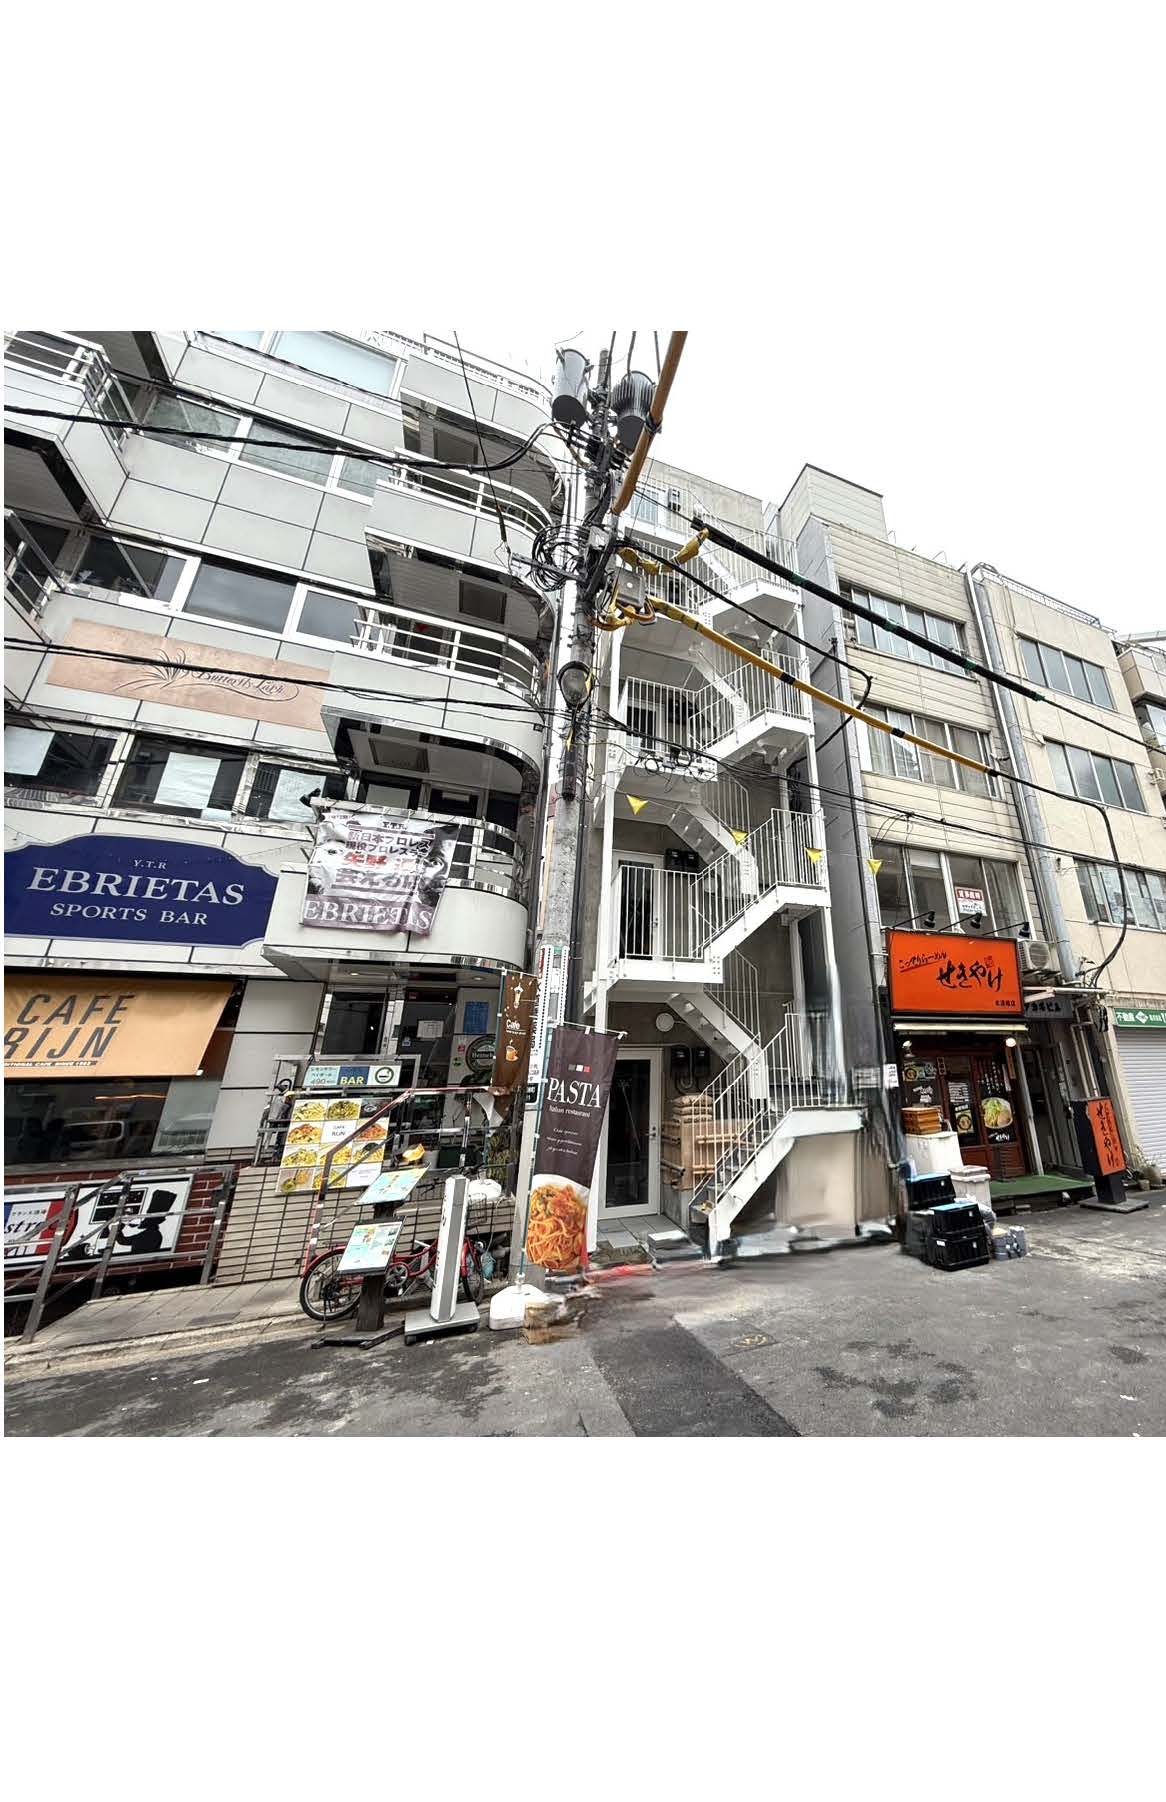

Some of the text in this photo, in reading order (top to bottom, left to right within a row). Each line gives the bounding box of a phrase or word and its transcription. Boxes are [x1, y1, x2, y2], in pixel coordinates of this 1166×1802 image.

[26, 866, 245, 906] EBRIETAS
[50, 903, 209, 926] SPORTS BAR
[936, 960, 1004, 992] せきやけ
[17, 993, 137, 1025] CAFE
[340, 1076, 364, 1085] BAR
[547, 1077, 601, 1109] PASTA
